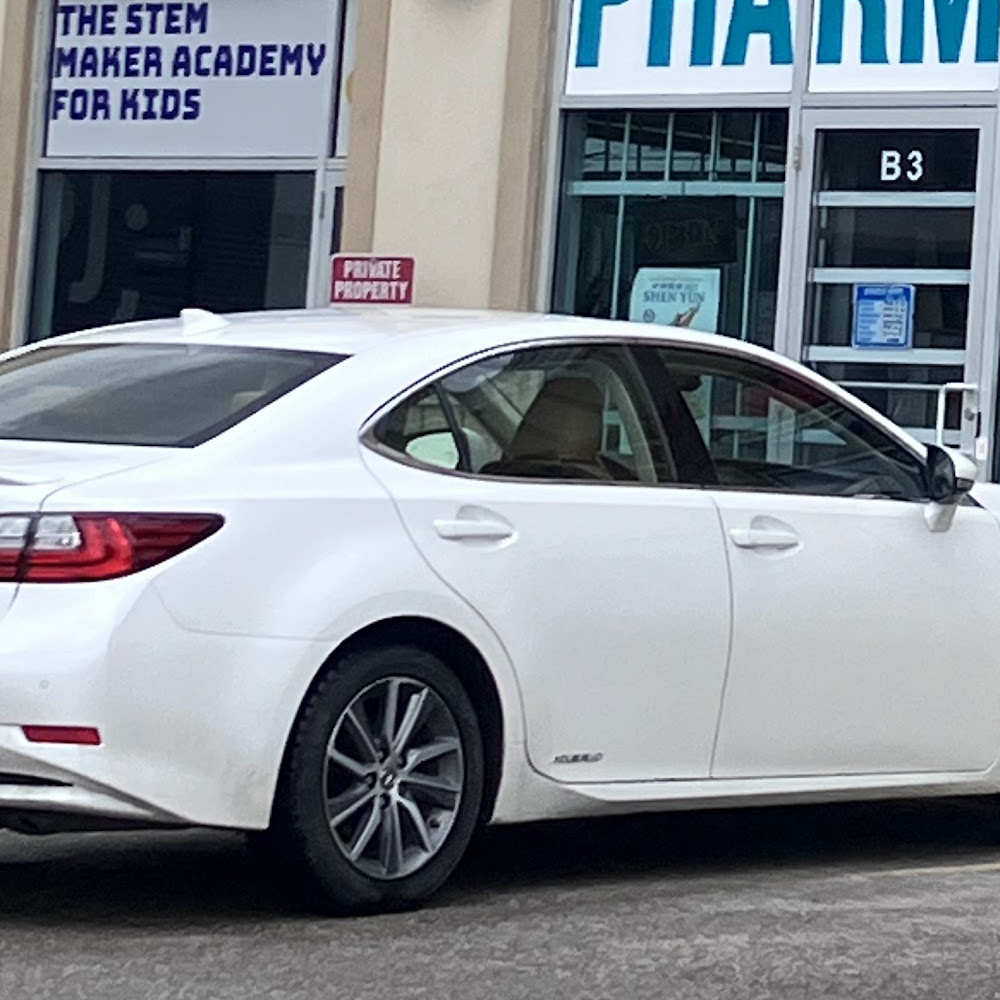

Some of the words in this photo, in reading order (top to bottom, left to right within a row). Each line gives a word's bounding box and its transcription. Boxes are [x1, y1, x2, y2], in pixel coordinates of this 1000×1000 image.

[57, 3, 119, 36] THE
[125, 2, 209, 35] STEM
[53, 46, 163, 78] MAKER
[171, 43, 327, 77] ACADEMY
[51, 88, 111, 120] FOR
[119, 88, 201, 120] KIDS
[880, 150, 923, 182] B3
[343, 260, 401, 279] PRIVATE
[333, 281, 409, 300] PROPERTY
[643, 291, 677, 303] SHEN
